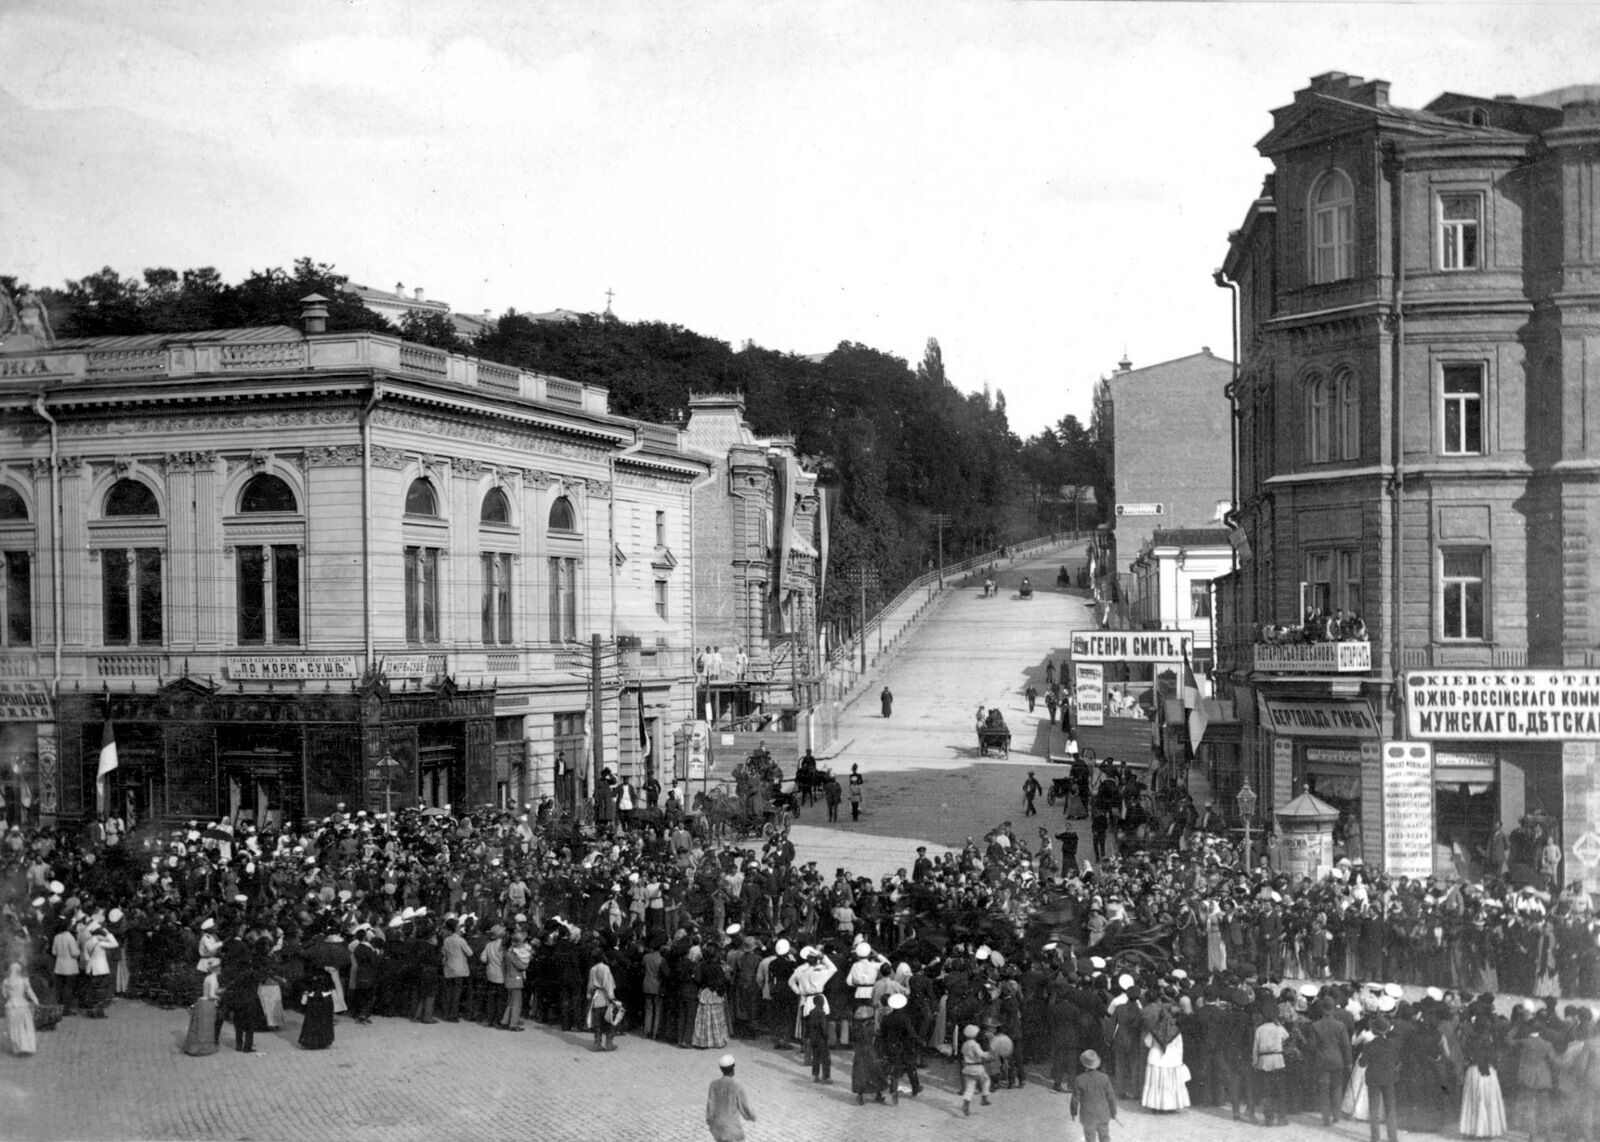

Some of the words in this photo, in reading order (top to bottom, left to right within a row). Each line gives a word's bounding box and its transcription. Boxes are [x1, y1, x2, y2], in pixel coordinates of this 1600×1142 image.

[1090, 636, 1127, 656] ГЕНРИ
[1133, 636, 1173, 656] СМИТЪ
[262, 663, 297, 673] МОРЮ
[1427, 675, 1535, 686] КІЕВСКОЕ
[1272, 709, 1331, 728] БЕРТОЛЬДЪ
[1332, 710, 1372, 728] ГИРШЪ
[1419, 711, 1517, 733] МУЖСКАГО
